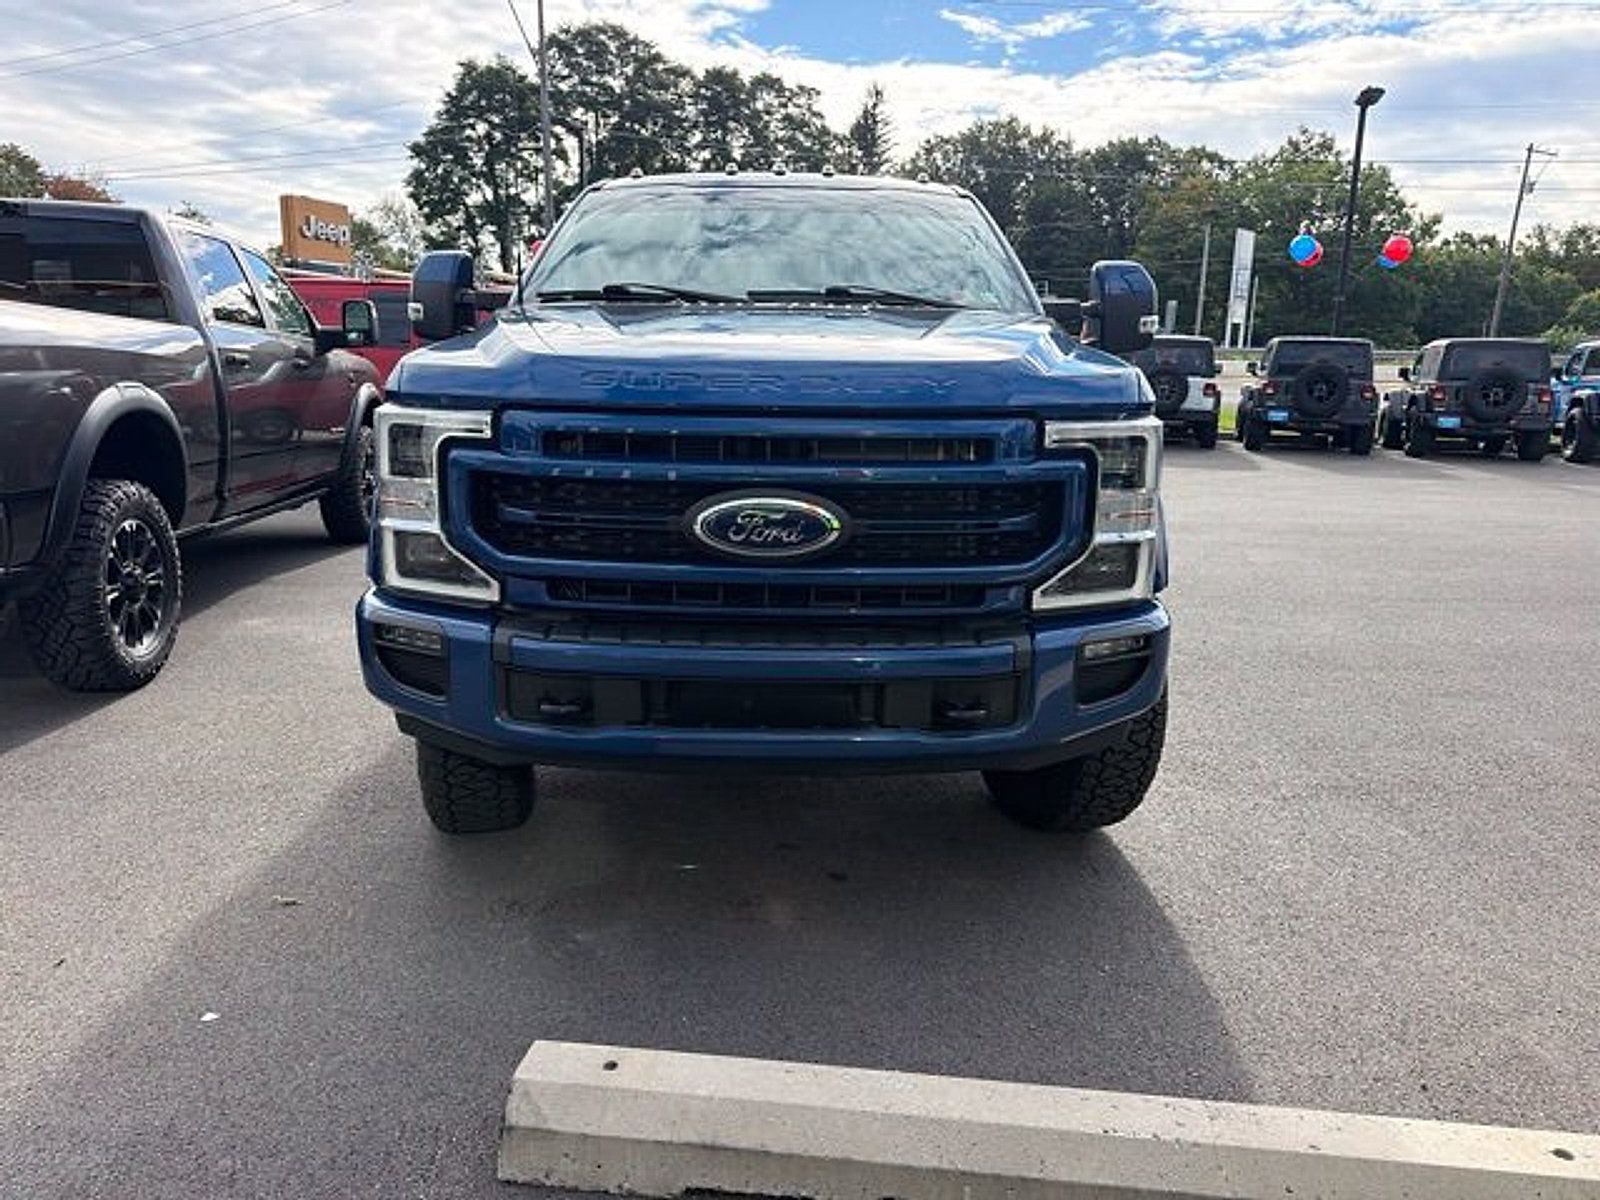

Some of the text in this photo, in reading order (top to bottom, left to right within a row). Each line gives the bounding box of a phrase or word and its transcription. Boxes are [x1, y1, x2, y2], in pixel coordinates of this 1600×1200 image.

[302, 214, 351, 246] Jeep
[579, 369, 783, 393] SUPER
[727, 509, 805, 543] Ford
